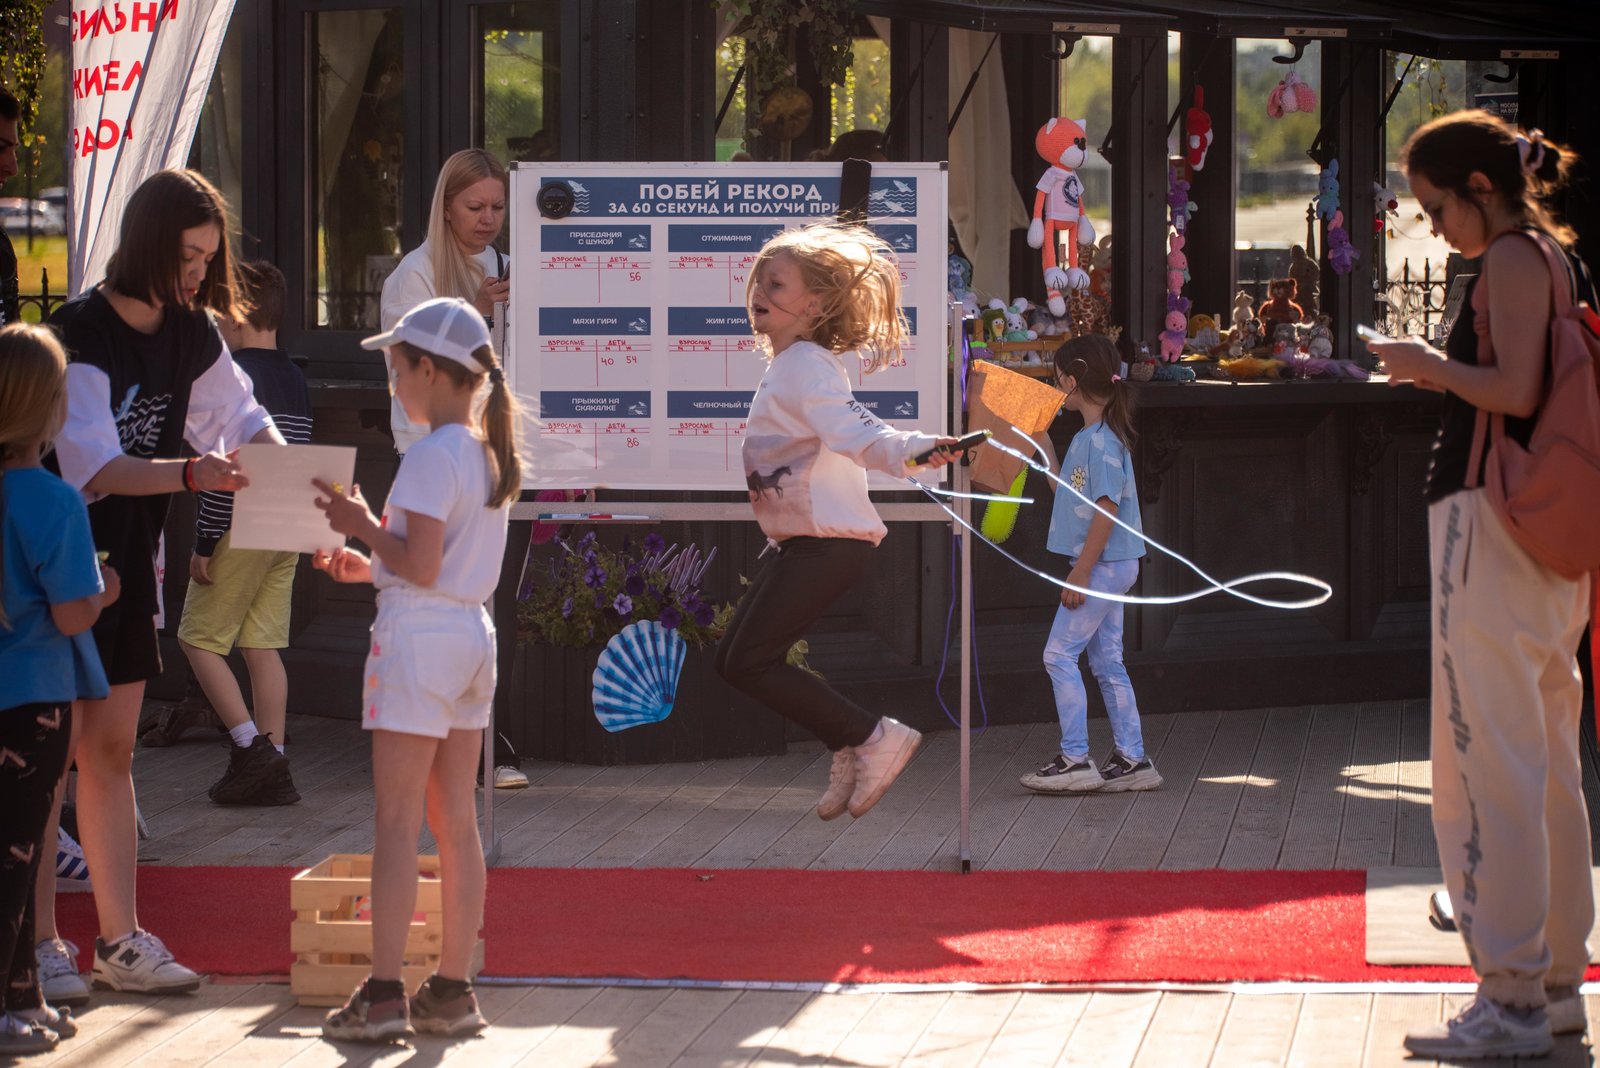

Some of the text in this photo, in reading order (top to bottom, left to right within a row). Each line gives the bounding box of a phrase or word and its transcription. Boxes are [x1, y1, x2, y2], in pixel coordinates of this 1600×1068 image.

[639, 180, 822, 201] ПОБЕЙ РЕКОРД
[608, 202, 628, 214] ЗА
[631, 202, 651, 214] 60
[655, 202, 720, 214] СЕКУНД
[723, 202, 734, 214] И
[739, 202, 805, 214] ПОЛУЧИ
[629, 271, 642, 282] 56
[600, 357, 614, 366] 40
[625, 355, 637, 364] 54
[693, 400, 741, 408] ЧЕЛНОЧНЫЙ
[846, 400, 878, 427] ADVE
[626, 437, 640, 448] 86
[118, 948, 141, 967] N
